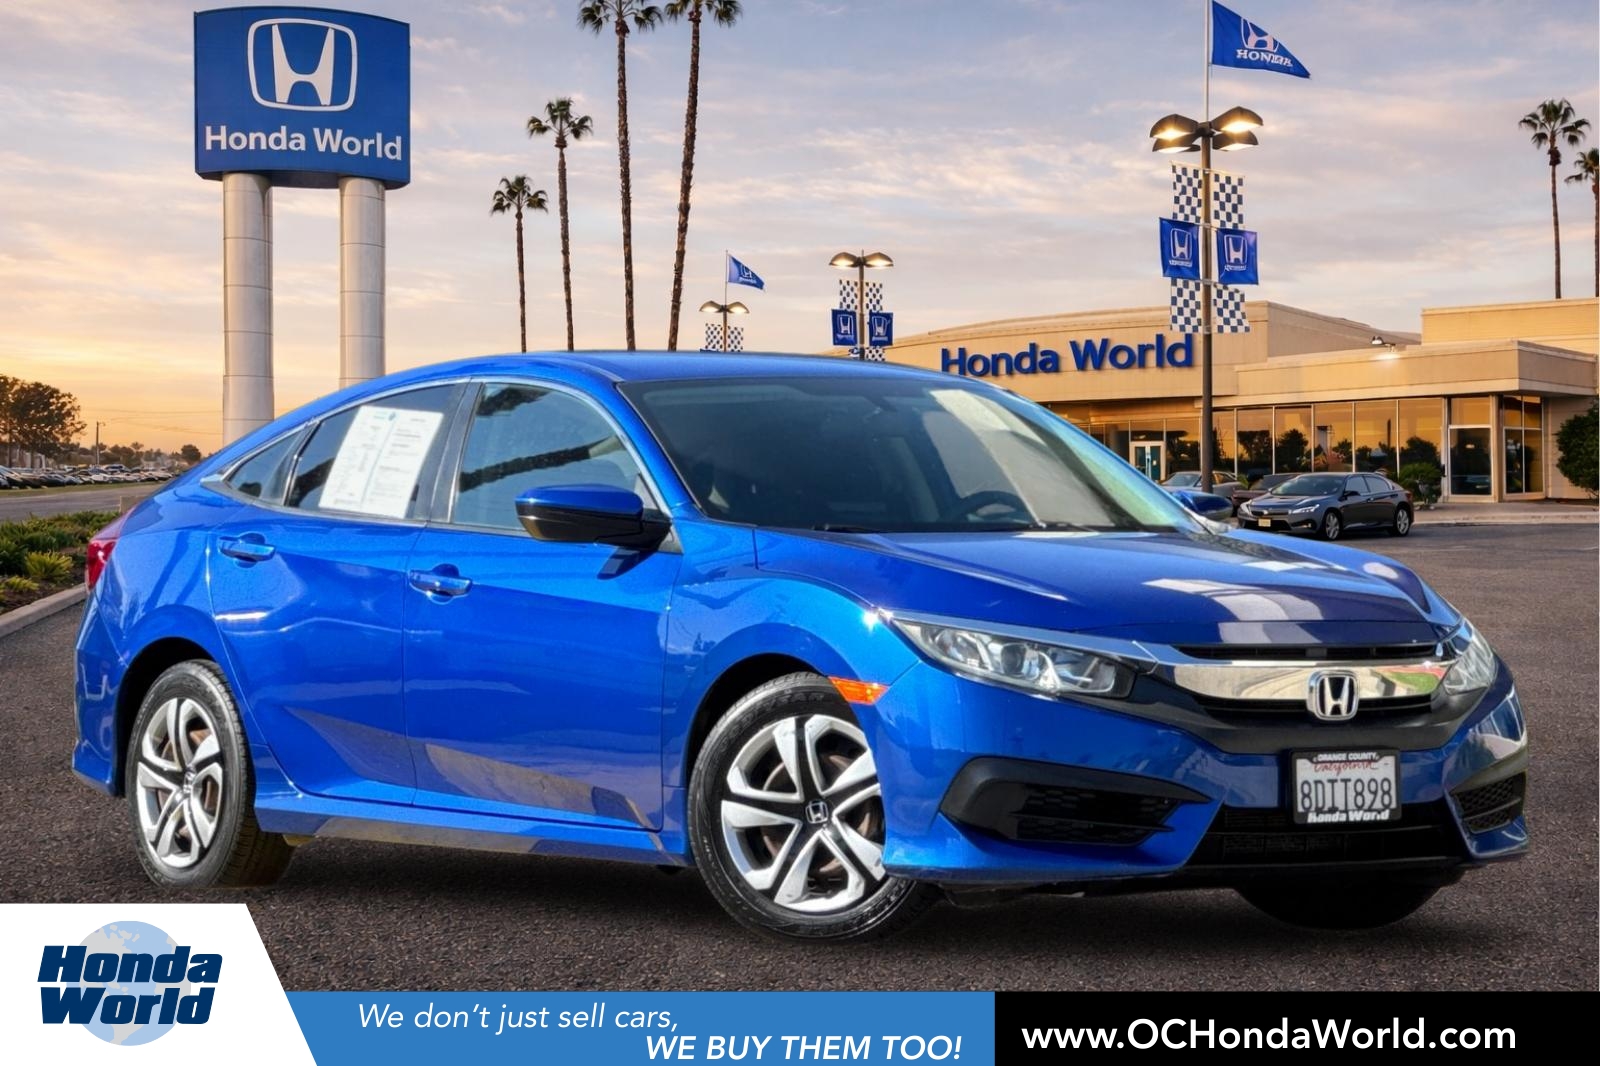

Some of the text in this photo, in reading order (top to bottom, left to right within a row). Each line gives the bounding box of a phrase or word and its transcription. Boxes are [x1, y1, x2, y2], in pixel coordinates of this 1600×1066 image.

[205, 125, 402, 161] Honda World
[941, 333, 1195, 377] Honda World
[1301, 778, 1392, 813] 8DIT898
[1307, 809, 1390, 823] Honda World
